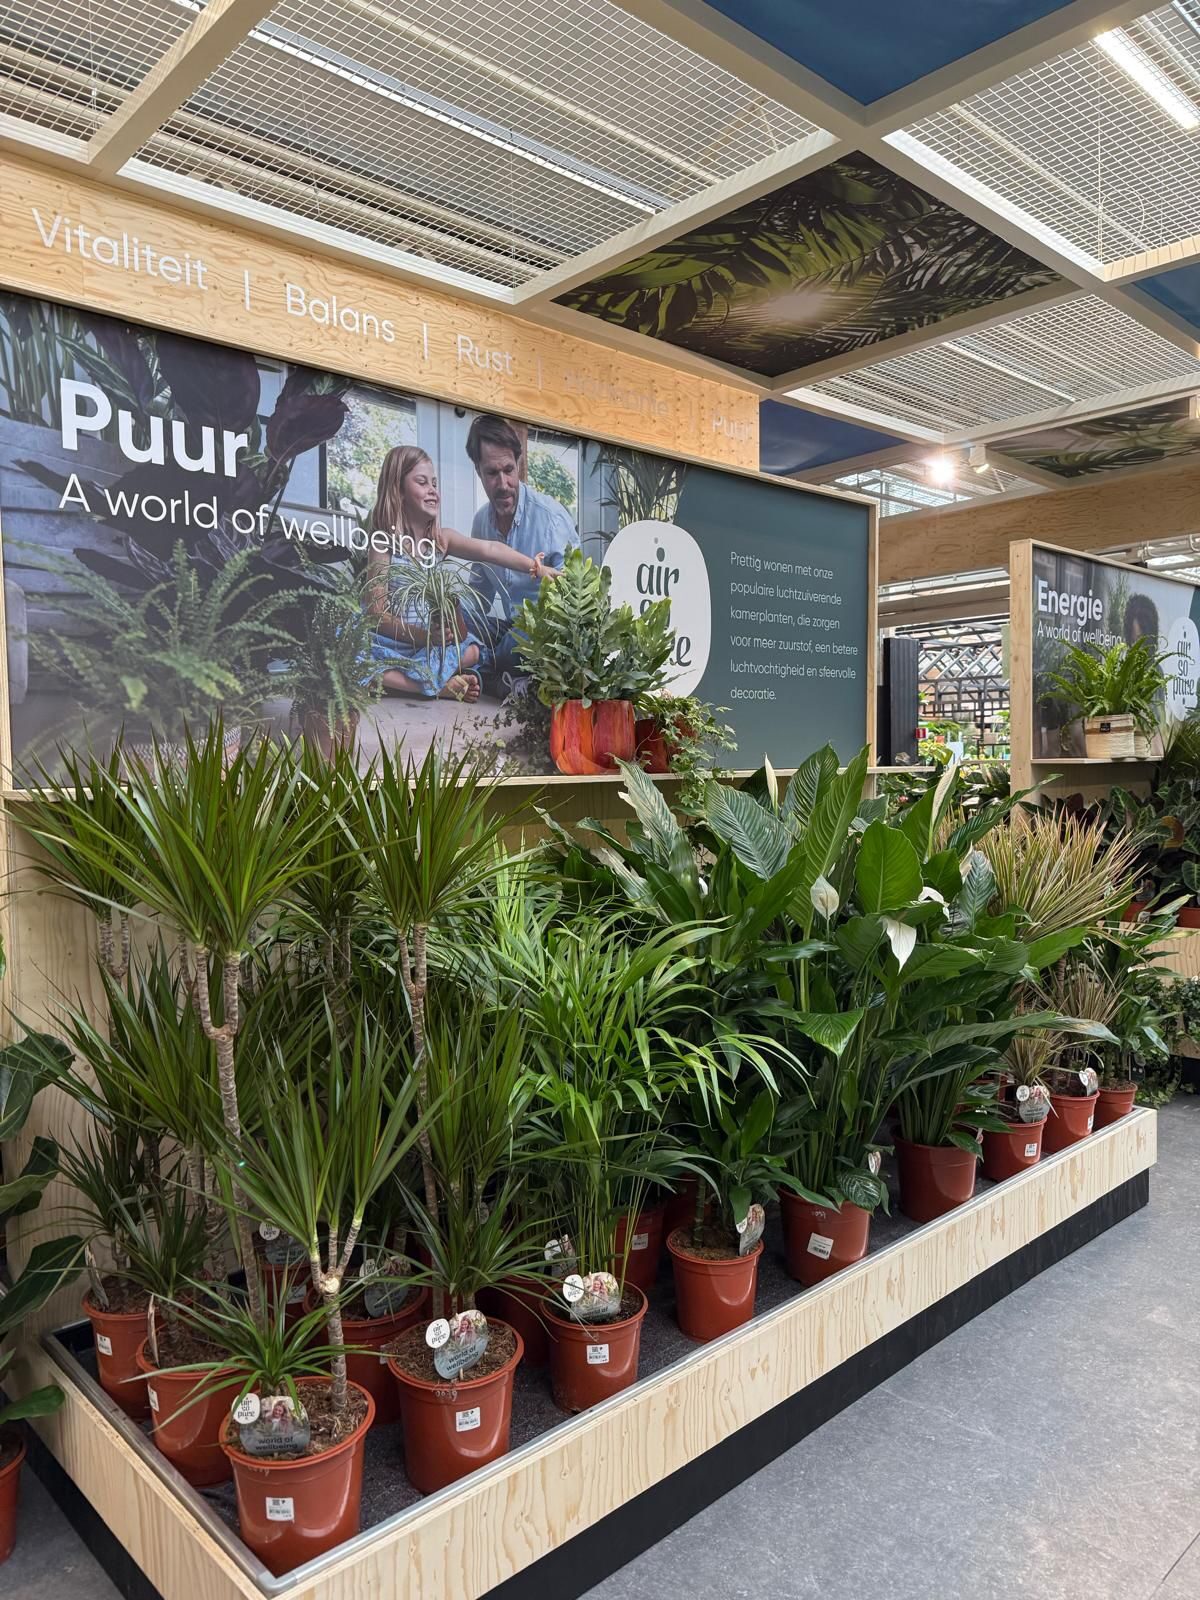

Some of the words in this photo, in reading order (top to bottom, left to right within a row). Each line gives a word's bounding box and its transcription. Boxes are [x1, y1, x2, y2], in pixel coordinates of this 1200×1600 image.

[32, 207, 208, 291] Vitaliteit
[285, 282, 396, 343] Balans
[456, 335, 513, 376] Rust
[60, 377, 248, 478] Puur
[58, 473, 91, 513] A
[104, 490, 218, 529] world
[232, 503, 271, 536] of
[281, 513, 437, 568] wellbeing
[636, 547, 680, 597] air
[730, 551, 761, 572] Prettig
[763, 560, 793, 573] wonen
[795, 564, 812, 577] met
[813, 568, 833, 579] onze
[730, 581, 774, 596] populaire
[776, 585, 842, 605] luchtzuiverende
[1038, 579, 1103, 626] Energie
[730, 605, 795, 627] kamerplanten,
[797, 613, 810, 626] die
[812, 617, 840, 630] zorgen
[1037, 620, 1044, 637] A
[1045, 624, 1070, 641] world
[1072, 627, 1081, 642] of
[730, 635, 751, 647] voor
[753, 637, 776, 649] meer
[778, 640, 813, 653] zuurstof,
[815, 643, 831, 653] een
[832, 642, 858, 655] betere
[730, 659, 805, 678] luchtvochtigheid
[807, 667, 817, 677] en
[819, 665, 856, 679] sfeervolle
[1178, 660, 1188, 676] so
[730, 686, 776, 700] decoratie.
[1173, 676, 1194, 700] pure
[446, 1352, 479, 1371] wellbeing
[448, 1349, 468, 1363] world
